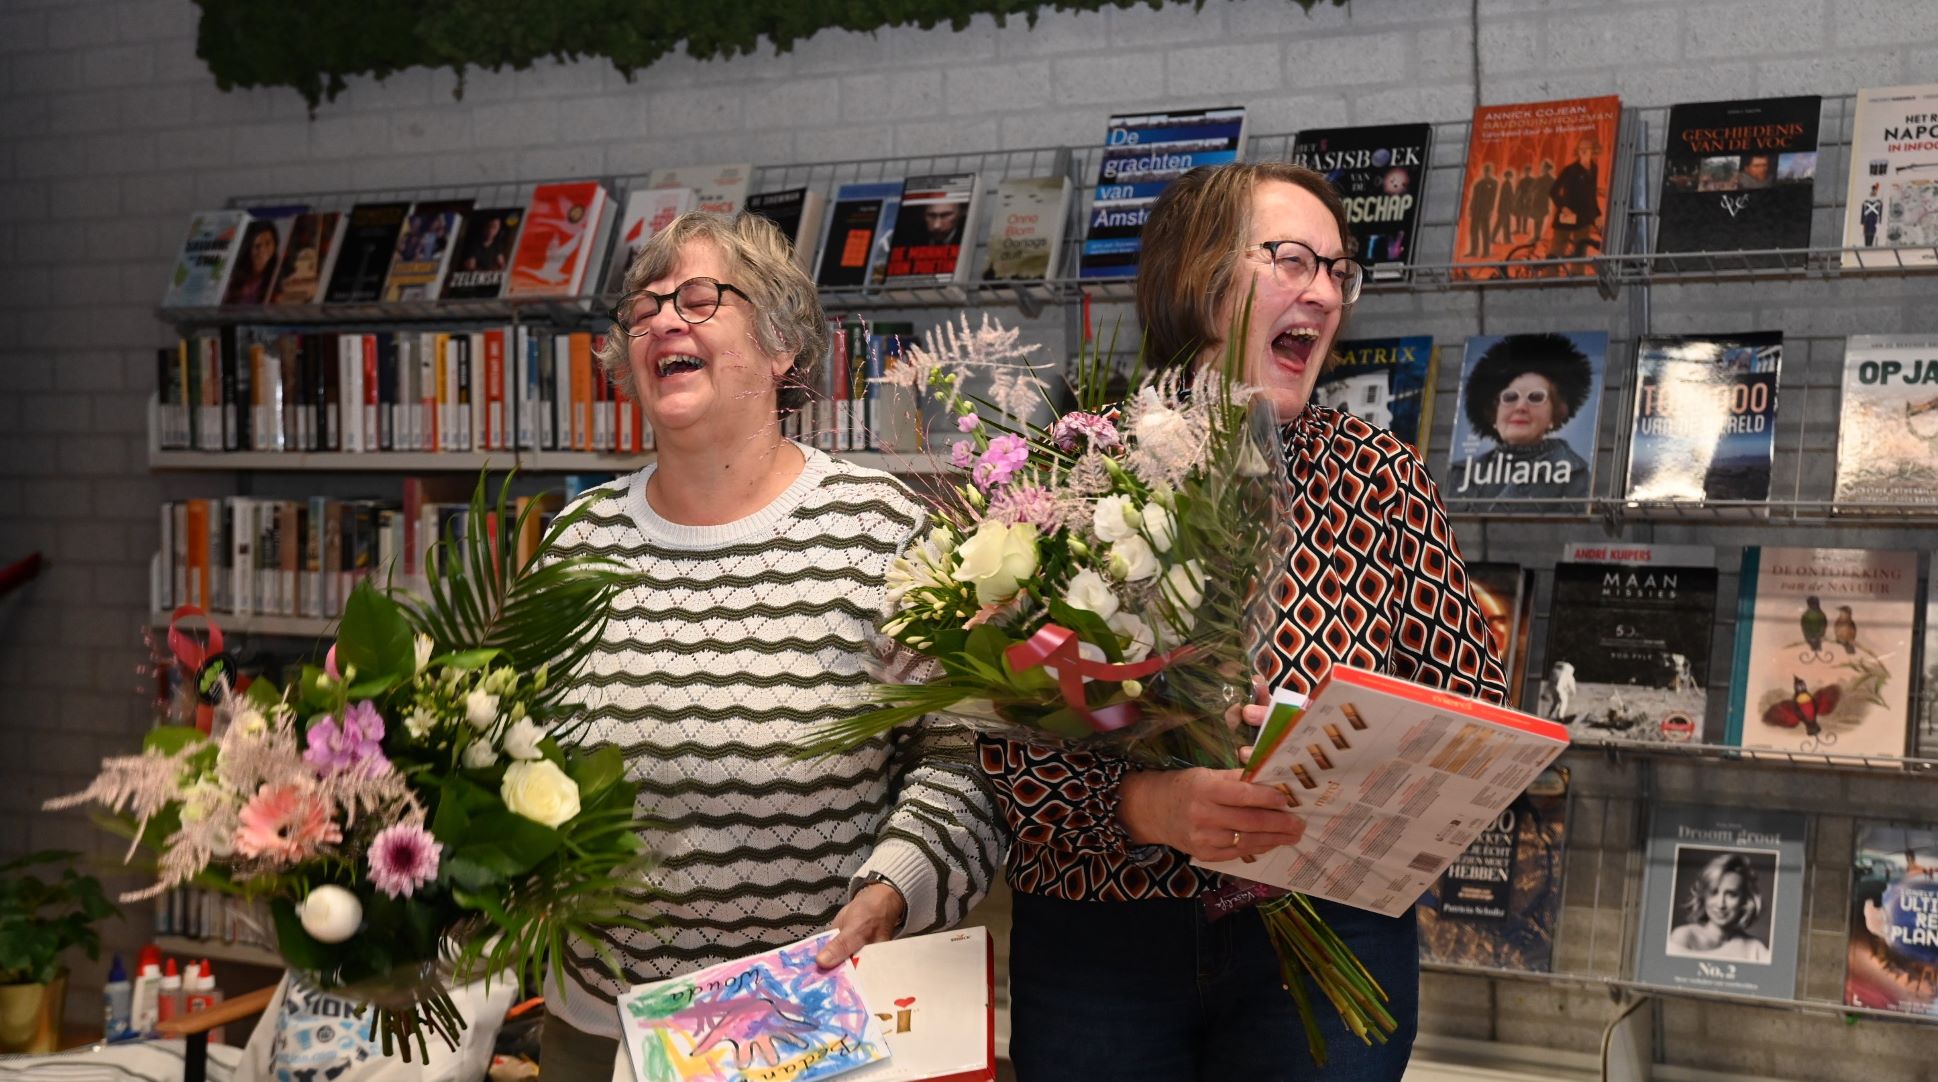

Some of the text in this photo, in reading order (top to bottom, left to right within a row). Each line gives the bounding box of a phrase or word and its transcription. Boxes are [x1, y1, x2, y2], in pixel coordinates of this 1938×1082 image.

[1485, 105, 1586, 120] ANNICK COJEAN
[1905, 114, 1927, 123] HET
[1110, 128, 1139, 146] De
[1681, 123, 1804, 142] GESCHIEDENIS
[1691, 136, 1790, 152] VAN DE VOC
[1888, 143, 1901, 152] IN
[1103, 152, 1193, 179] grachten
[1101, 185, 1134, 200] van
[1341, 194, 1413, 223] NSCHAP
[450, 271, 502, 288] ZELENSK
[1343, 347, 1416, 365] ATRIX
[1723, 382, 1769, 415] 00
[1704, 415, 1765, 434] RELD
[1457, 452, 1572, 492] Juliana
[1574, 547, 1652, 561] ANDRÉ KUIPERS
[1602, 572, 1678, 588] MAAN
[1772, 565, 1902, 578] DE ONTDEKKING
[1602, 588, 1677, 599] MISSIES
[1828, 582, 1891, 593] NATUUR
[1679, 824, 1733, 840] Droom
[1735, 829, 1781, 846] groot
[1448, 864, 1509, 882] HEBBEN
[670, 968, 765, 1003] Wouda
